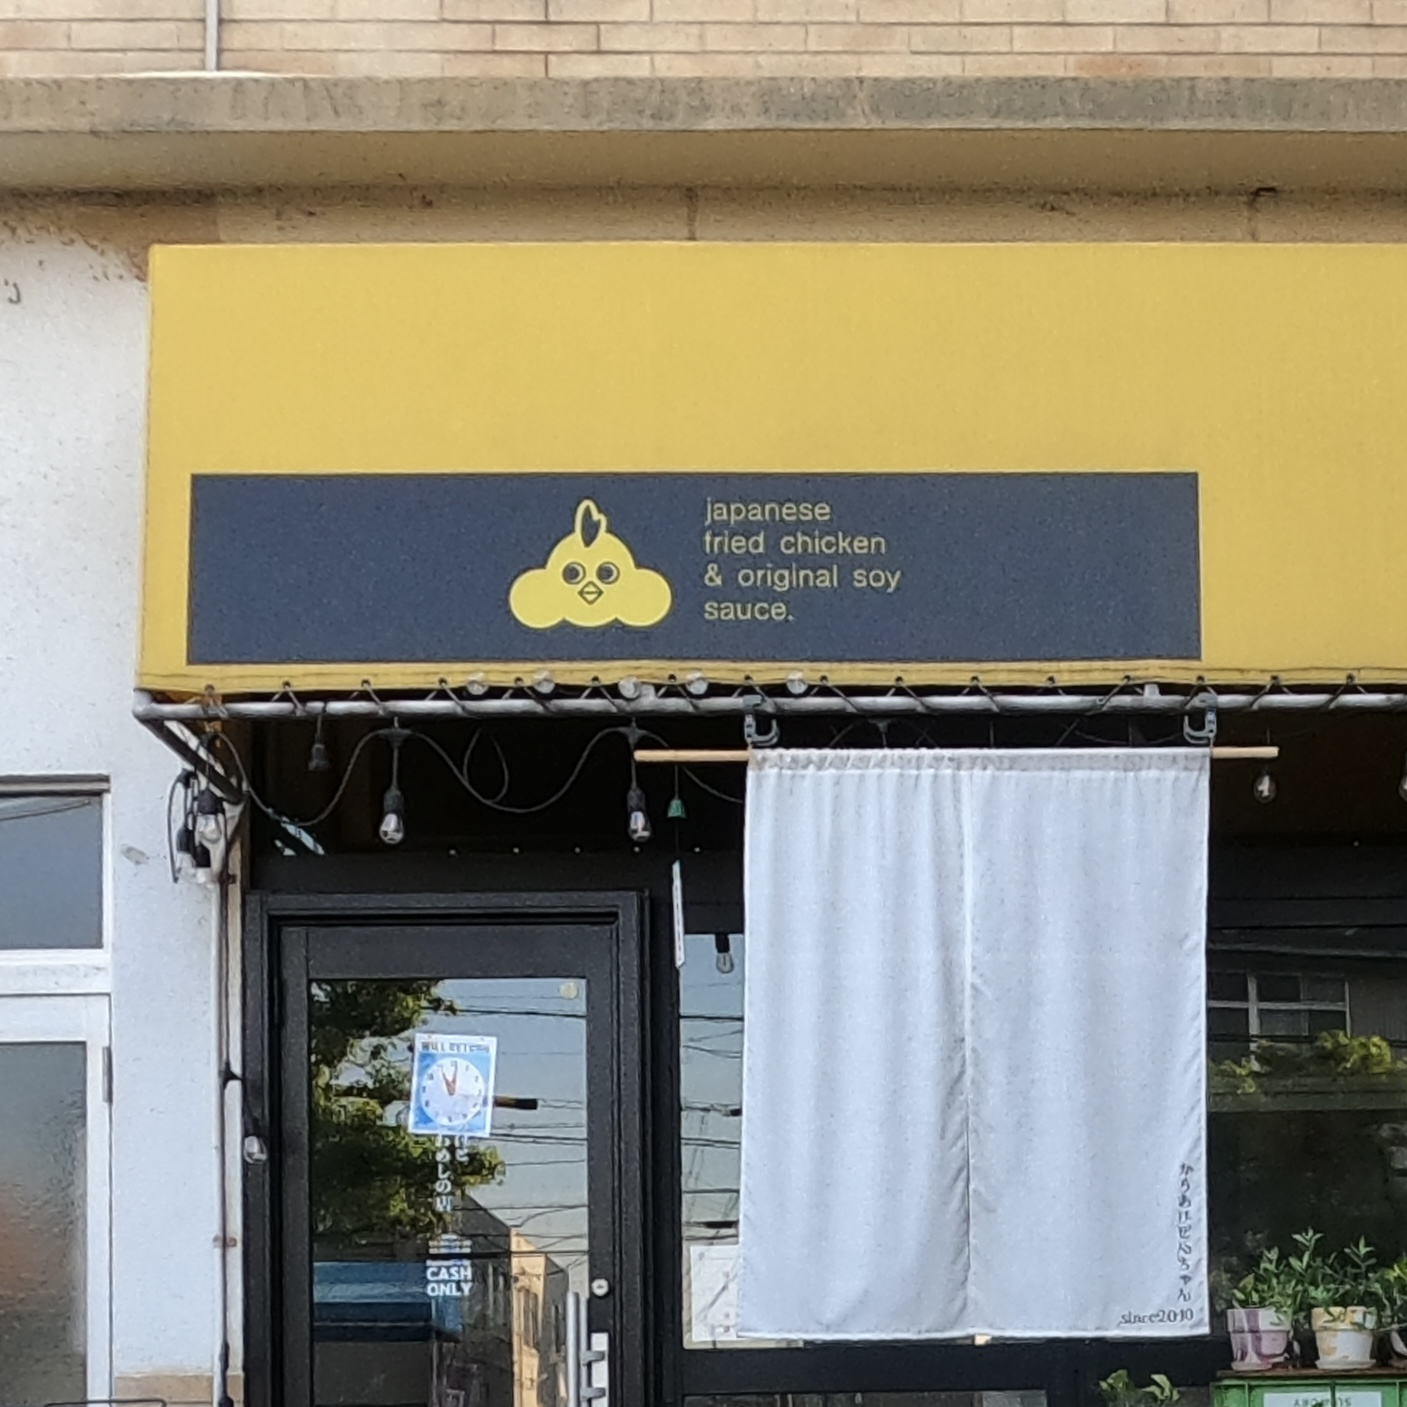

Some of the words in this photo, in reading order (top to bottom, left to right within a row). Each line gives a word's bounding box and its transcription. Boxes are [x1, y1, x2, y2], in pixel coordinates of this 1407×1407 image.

[704, 497, 831, 527] japanese
[704, 529, 765, 554] fried
[780, 529, 886, 554] chicken
[704, 563, 723, 587] &
[737, 562, 838, 592] original
[852, 568, 901, 593] soy
[704, 601, 795, 621] sauce.
[426, 1267, 473, 1280] CASH
[427, 1282, 473, 1296] ONLY
